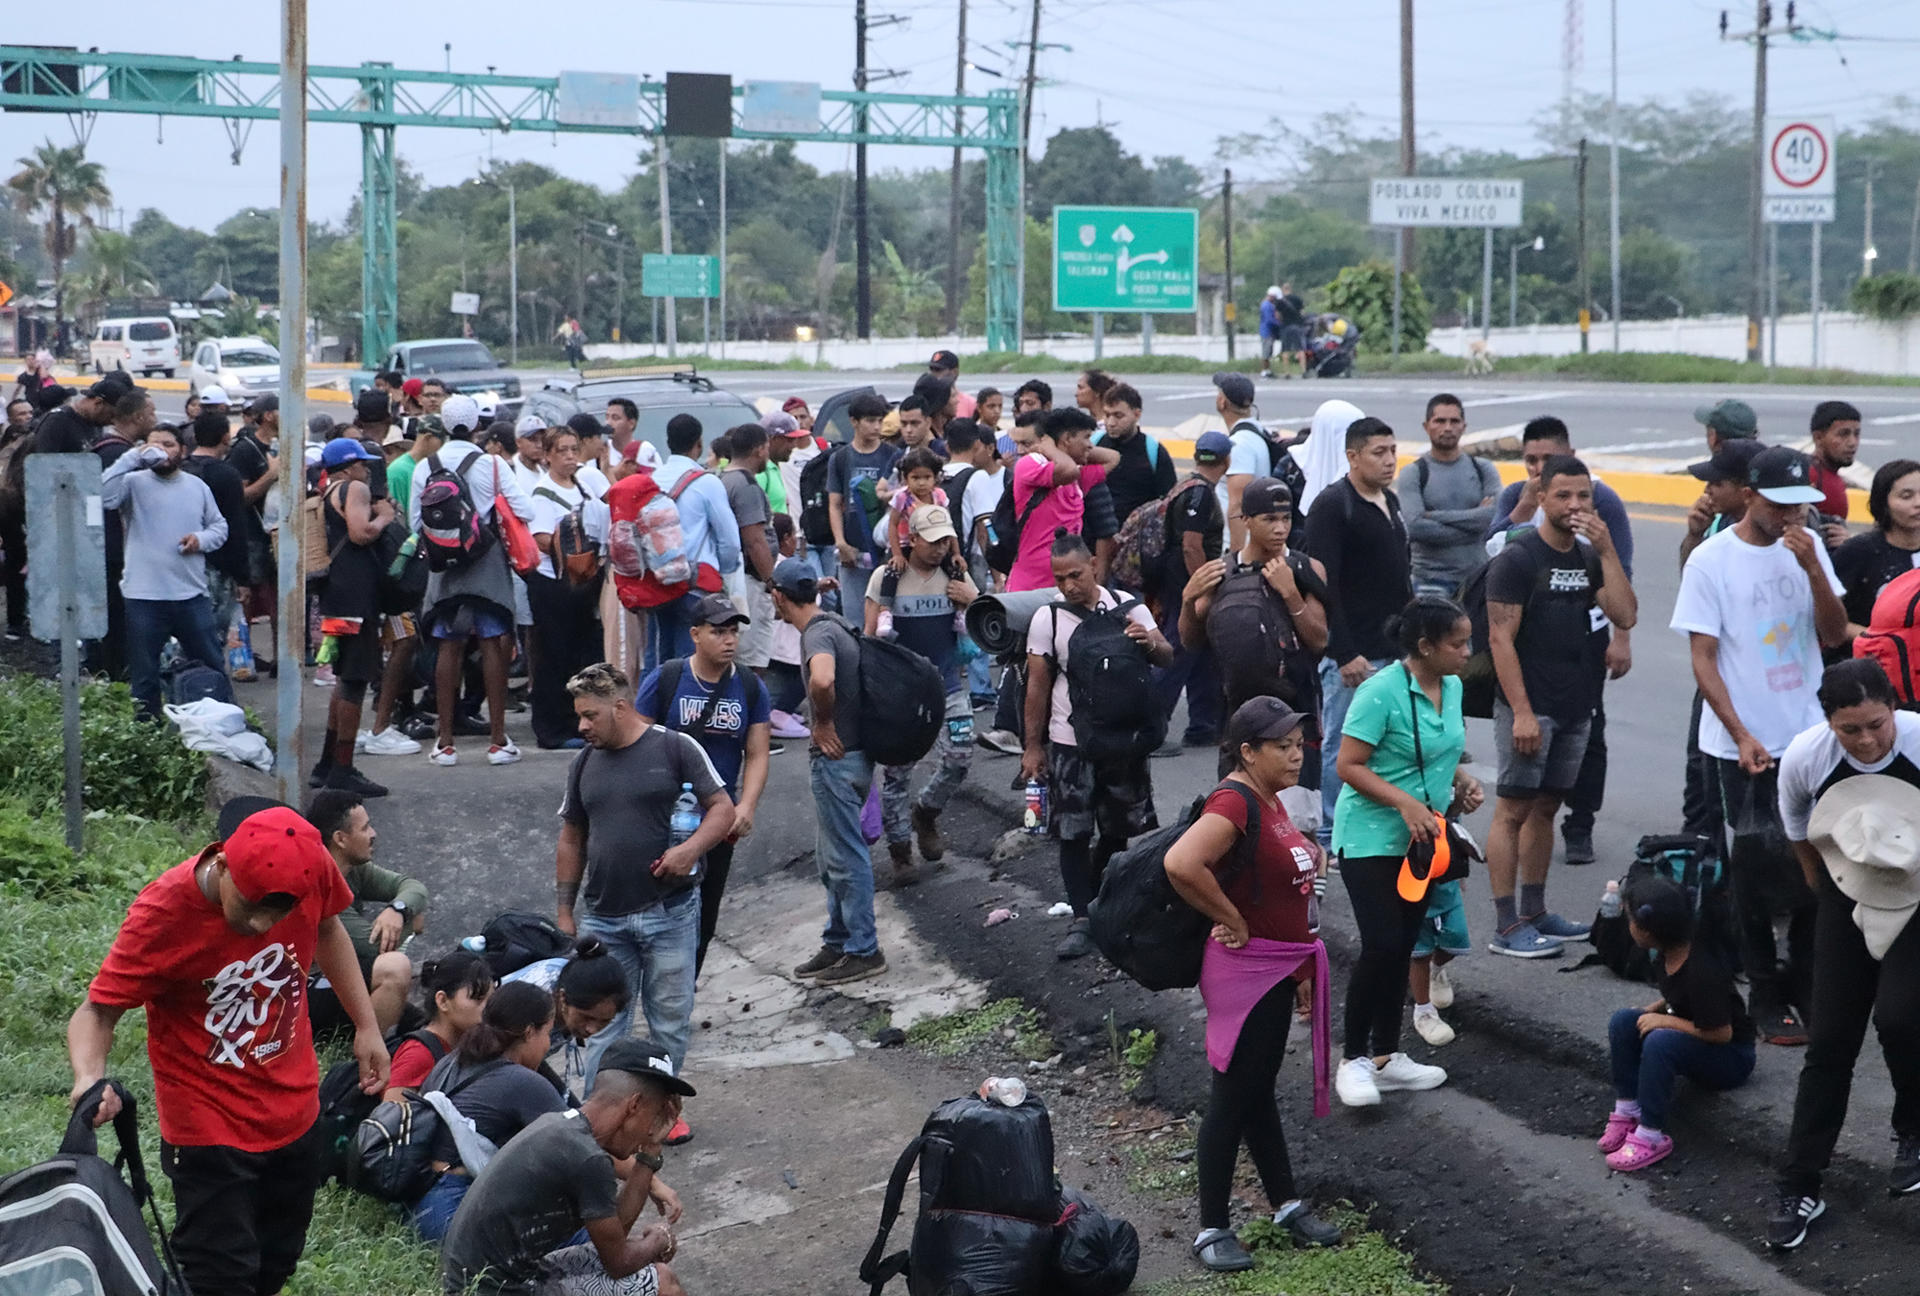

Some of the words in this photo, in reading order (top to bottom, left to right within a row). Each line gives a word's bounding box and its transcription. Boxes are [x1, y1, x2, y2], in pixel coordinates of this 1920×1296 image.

[1786, 136, 1814, 164] 40
[1376, 183, 1442, 199] POBLADO
[1456, 183, 1517, 199] COLONIA
[1397, 204, 1430, 219] VIVA
